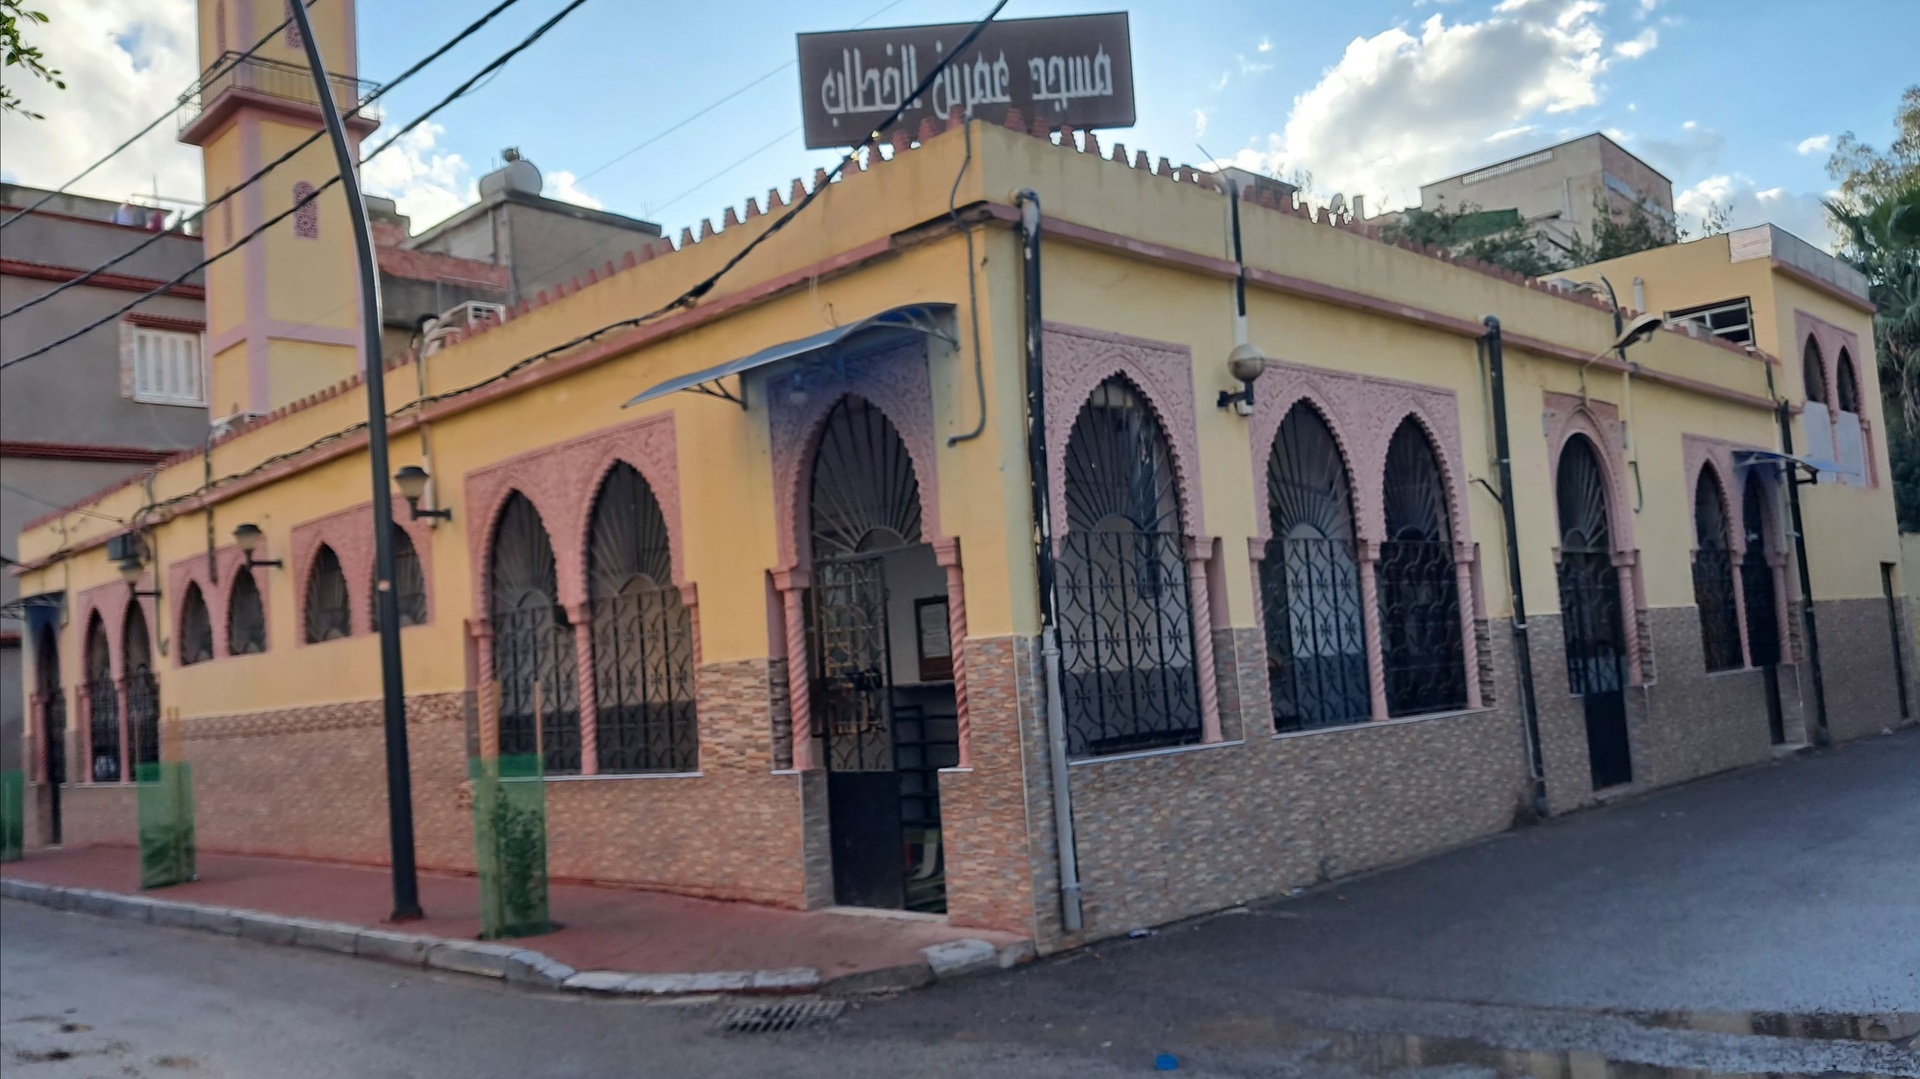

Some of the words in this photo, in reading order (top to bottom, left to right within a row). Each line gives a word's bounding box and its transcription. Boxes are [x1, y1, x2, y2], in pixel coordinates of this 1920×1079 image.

[821, 42, 923, 127] الخطاب
[932, 40, 962, 120] بن
[963, 48, 1012, 117] عمر
[1029, 43, 1114, 112] مسجد
